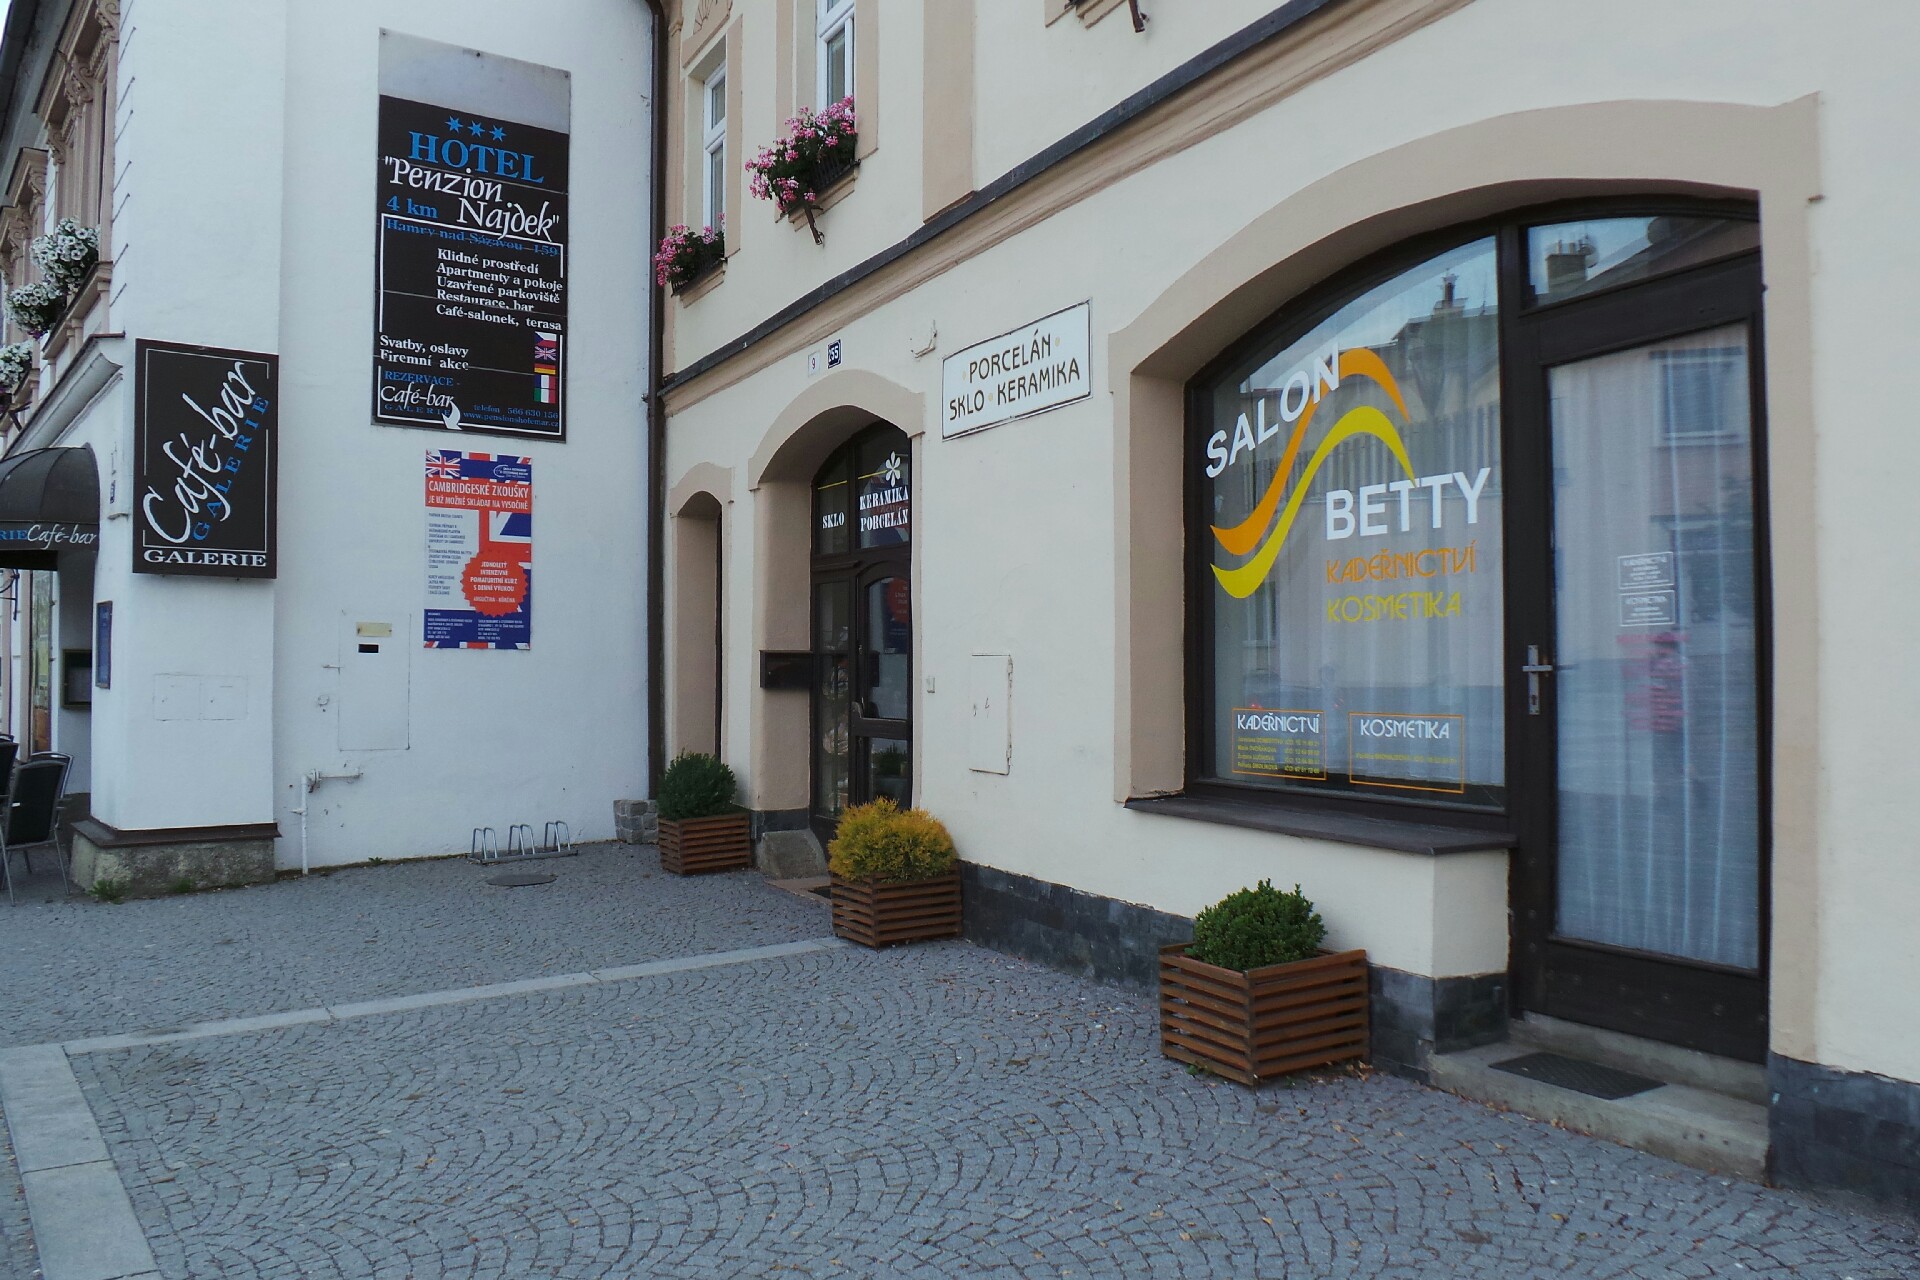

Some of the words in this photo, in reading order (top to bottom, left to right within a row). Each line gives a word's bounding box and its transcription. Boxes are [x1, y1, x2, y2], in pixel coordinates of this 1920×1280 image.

[408, 131, 544, 183] HOTEL
[385, 156, 503, 202] "Penzion
[386, 195, 400, 211] 4
[407, 199, 439, 218] km
[457, 198, 560, 242] Najdek"
[386, 219, 435, 237] Hamry
[440, 231, 465, 242] nad
[534, 244, 559, 256] 159
[437, 248, 479, 265] Klidné
[482, 258, 539, 275] prostředí
[436, 262, 510, 285] Apartmenty
[513, 276, 521, 285] a
[524, 277, 563, 292] pokoje
[437, 275, 494, 294] Uzavřené
[498, 286, 560, 304] parkoviště
[437, 288, 509, 310] Restaurace,
[513, 300, 535, 312] bar
[436, 303, 519, 327] Café-salonek,
[526, 317, 562, 331] terasa
[379, 334, 426, 354] Svatby,
[429, 343, 469, 359] oslavy
[379, 348, 432, 367] Firemní
[439, 357, 469, 371] akce
[969, 328, 1051, 384] PORCELÁN
[811, 357, 816, 370] 9
[384, 370, 454, 387] REZERVACE
[949, 389, 985, 421] SKLO
[997, 357, 1081, 406] KERAMIKA
[380, 381, 455, 410] Café-bar
[384, 403, 451, 416] GALERIE
[473, 403, 501, 414] telefon
[507, 407, 524, 416] 566
[525, 409, 541, 417] 630
[544, 411, 559, 419] 156
[1205, 341, 1341, 479] SALON
[142, 360, 257, 544] Café-bar
[192, 396, 269, 542] GALERIE
[428, 480, 490, 496] CAMBRIDGESKÉ
[491, 484, 529, 499] ZKOUŠKY
[428, 495, 435, 504] JE
[436, 494, 444, 504] UŽ
[445, 495, 466, 506] MOŽNÉ
[467, 497, 491, 508] SKLÁDAT
[492, 499, 501, 508] NA
[859, 485, 909, 511] KERAMIKA
[1326, 467, 1491, 541] BETTY
[822, 511, 845, 529] SKLO
[860, 506, 909, 532] PORCELÁN
[27, 523, 97, 551] Café-bar
[143, 549, 267, 568] GALERIE
[1326, 539, 1477, 584] KADEŘNICTVÍ
[1327, 591, 1462, 623] KOSMETIKA
[1236, 711, 1320, 734] KADEŘNICTVÍ
[1359, 718, 1450, 740] KOSMETIKA
